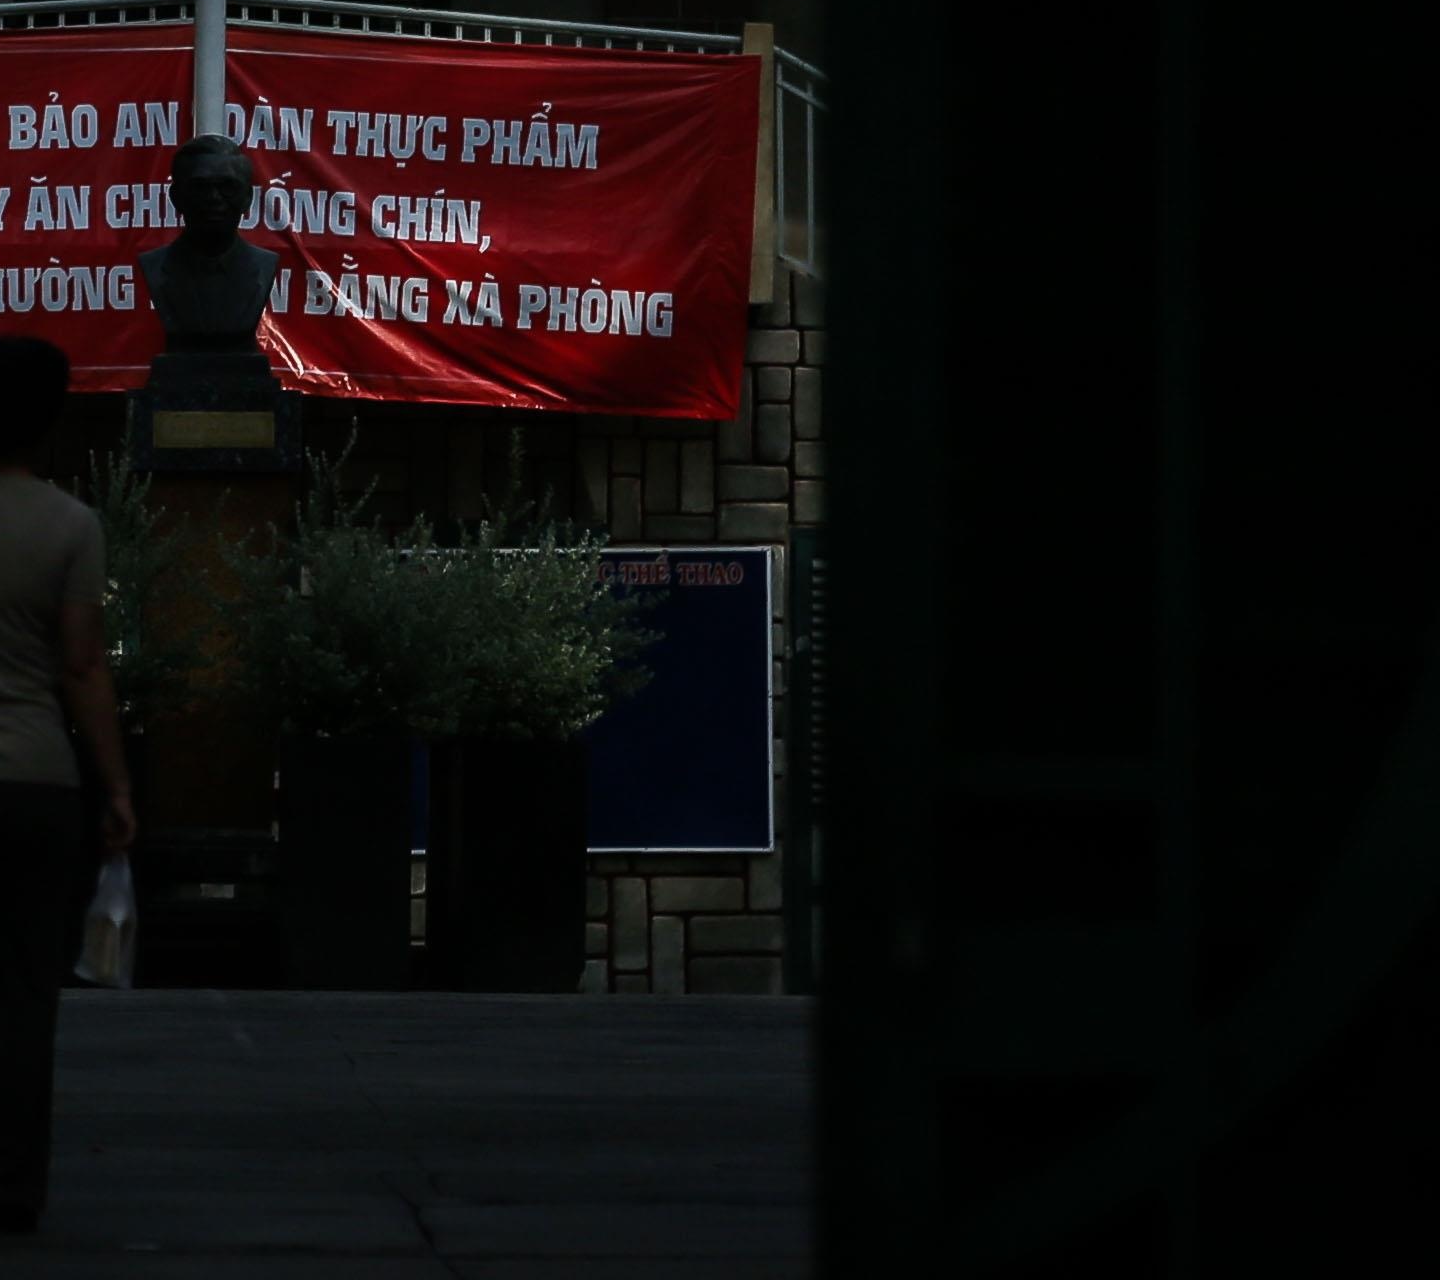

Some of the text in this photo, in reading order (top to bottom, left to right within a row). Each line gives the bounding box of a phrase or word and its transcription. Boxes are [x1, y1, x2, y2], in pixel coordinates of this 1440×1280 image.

[8, 91, 98, 149] BẢO
[113, 101, 179, 147] AN
[214, 95, 314, 152] OÀN
[326, 111, 449, 168] THỰC
[461, 102, 600, 169] PHẨM
[24, 176, 90, 231] ĂN
[371, 189, 492, 254] CHÍN,
[304, 254, 429, 324] BẰNG
[442, 272, 503, 327] XÀ
[517, 277, 674, 338] PHÒNG
[676, 561, 745, 586] THAO
